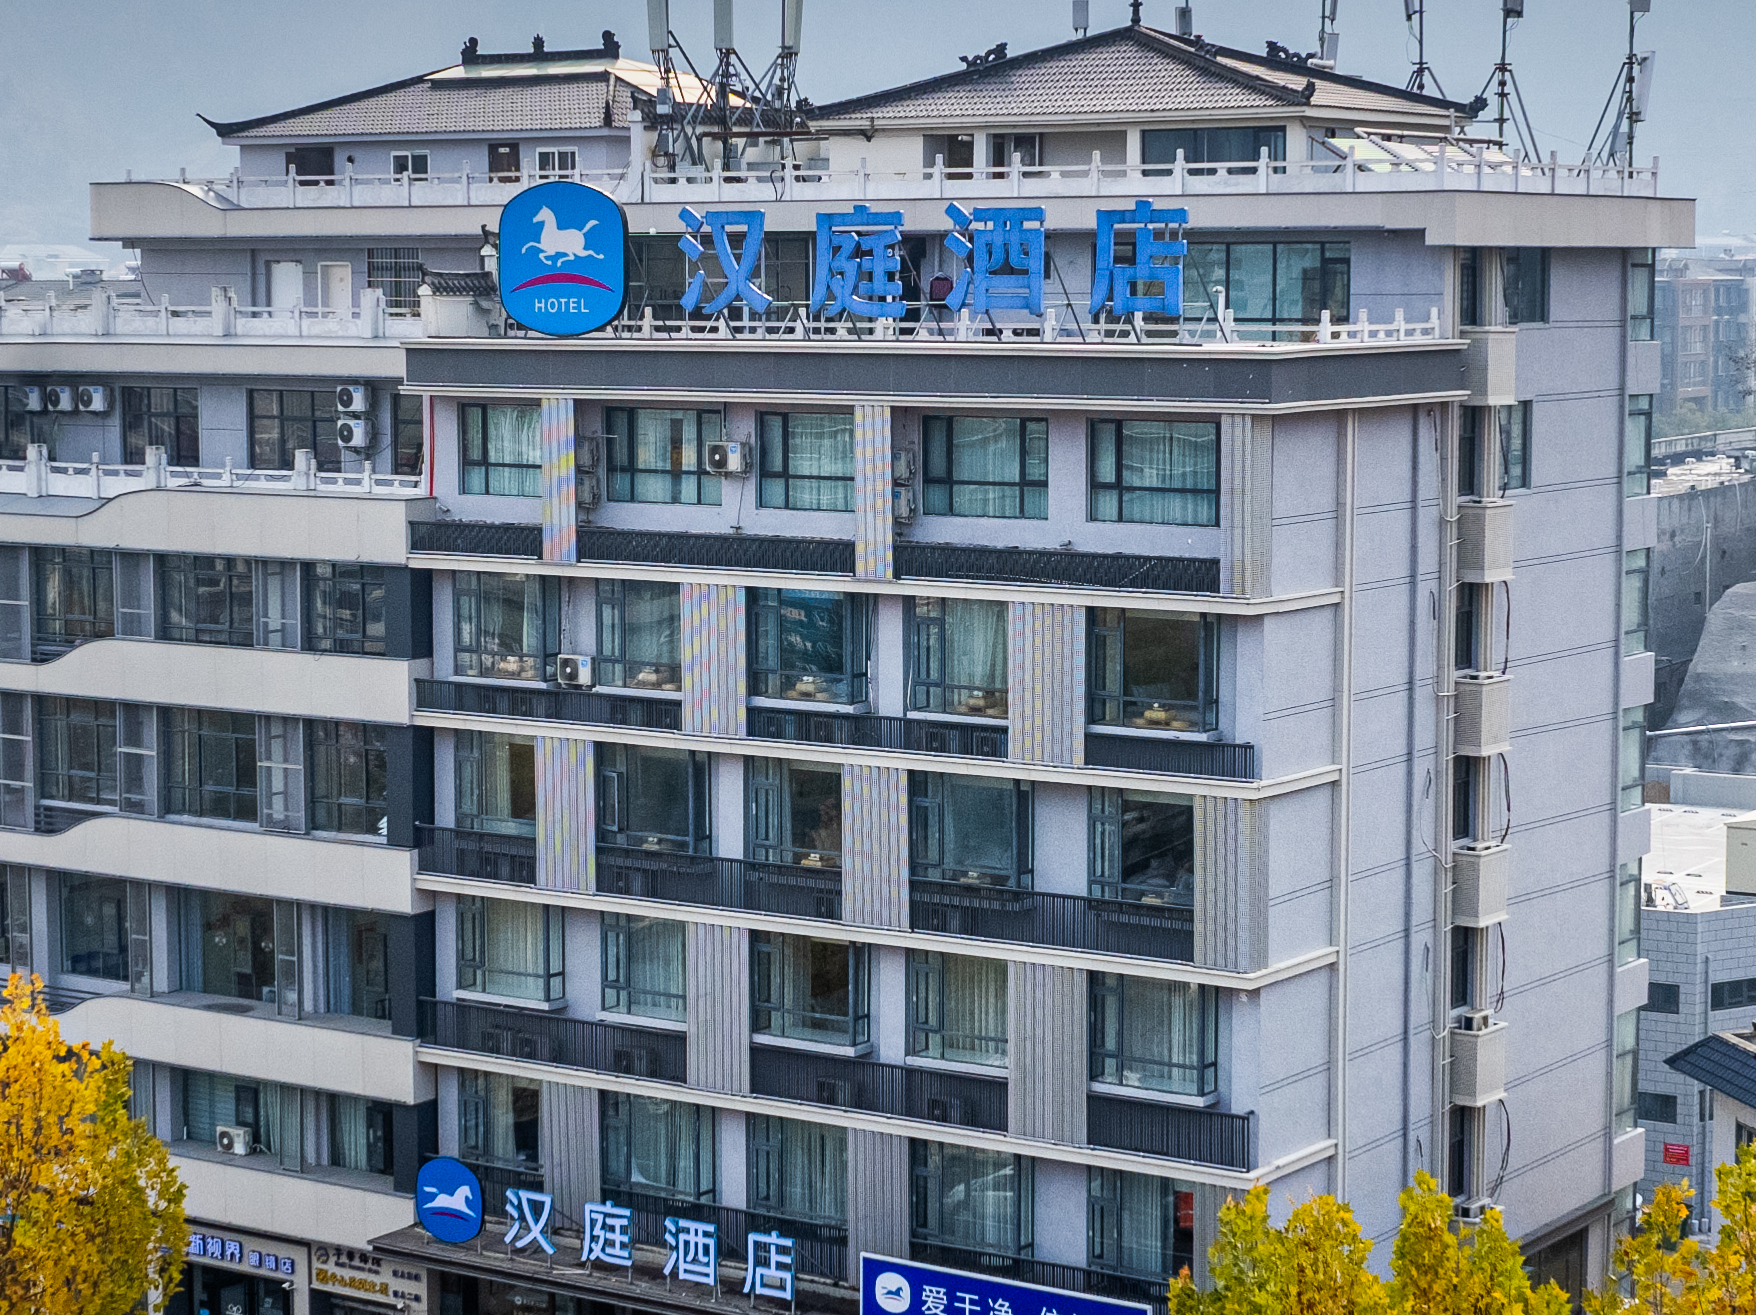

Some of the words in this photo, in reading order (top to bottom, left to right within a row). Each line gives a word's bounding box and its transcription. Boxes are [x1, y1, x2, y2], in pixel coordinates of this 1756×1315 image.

[677, 198, 1189, 319] 汉庭酒店
[534, 297, 590, 314] HOTEL
[188, 1233, 243, 1264] 新视界
[248, 1250, 294, 1275] 眼镜店
[503, 1187, 795, 1300] 汉庭酒店
